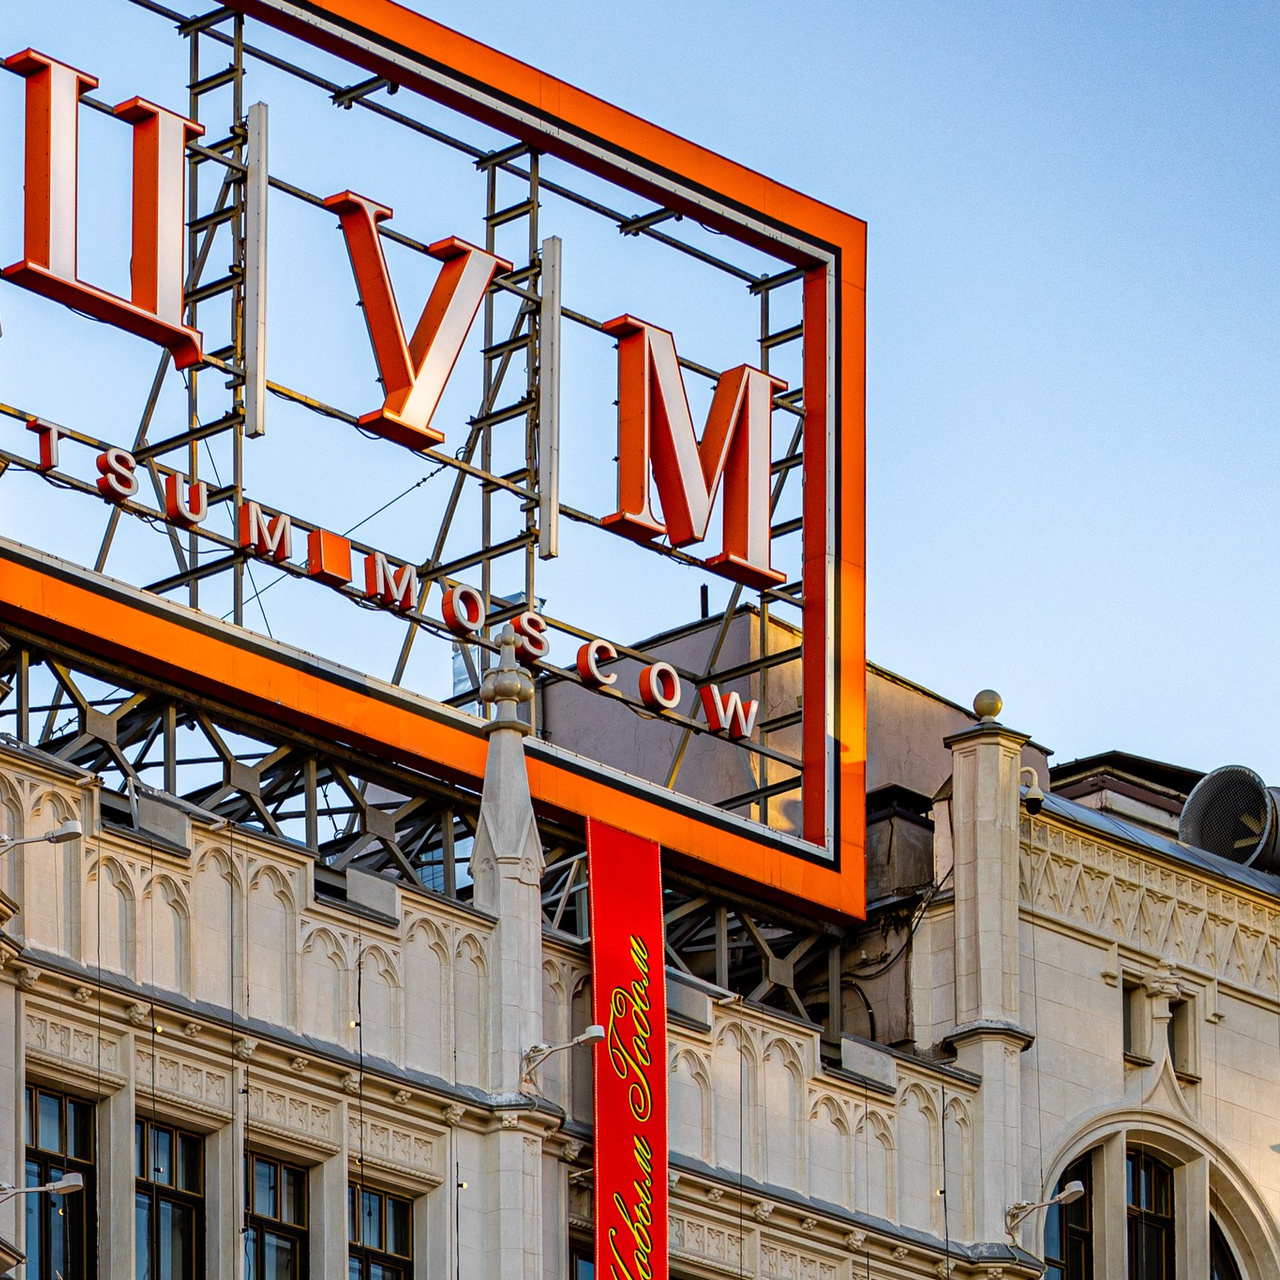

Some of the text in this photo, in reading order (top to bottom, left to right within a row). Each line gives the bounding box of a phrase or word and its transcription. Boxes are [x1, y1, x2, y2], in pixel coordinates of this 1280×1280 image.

[25, 418, 759, 742] TSUM MOSCOW
[608, 934, 653, 1123] Годом
